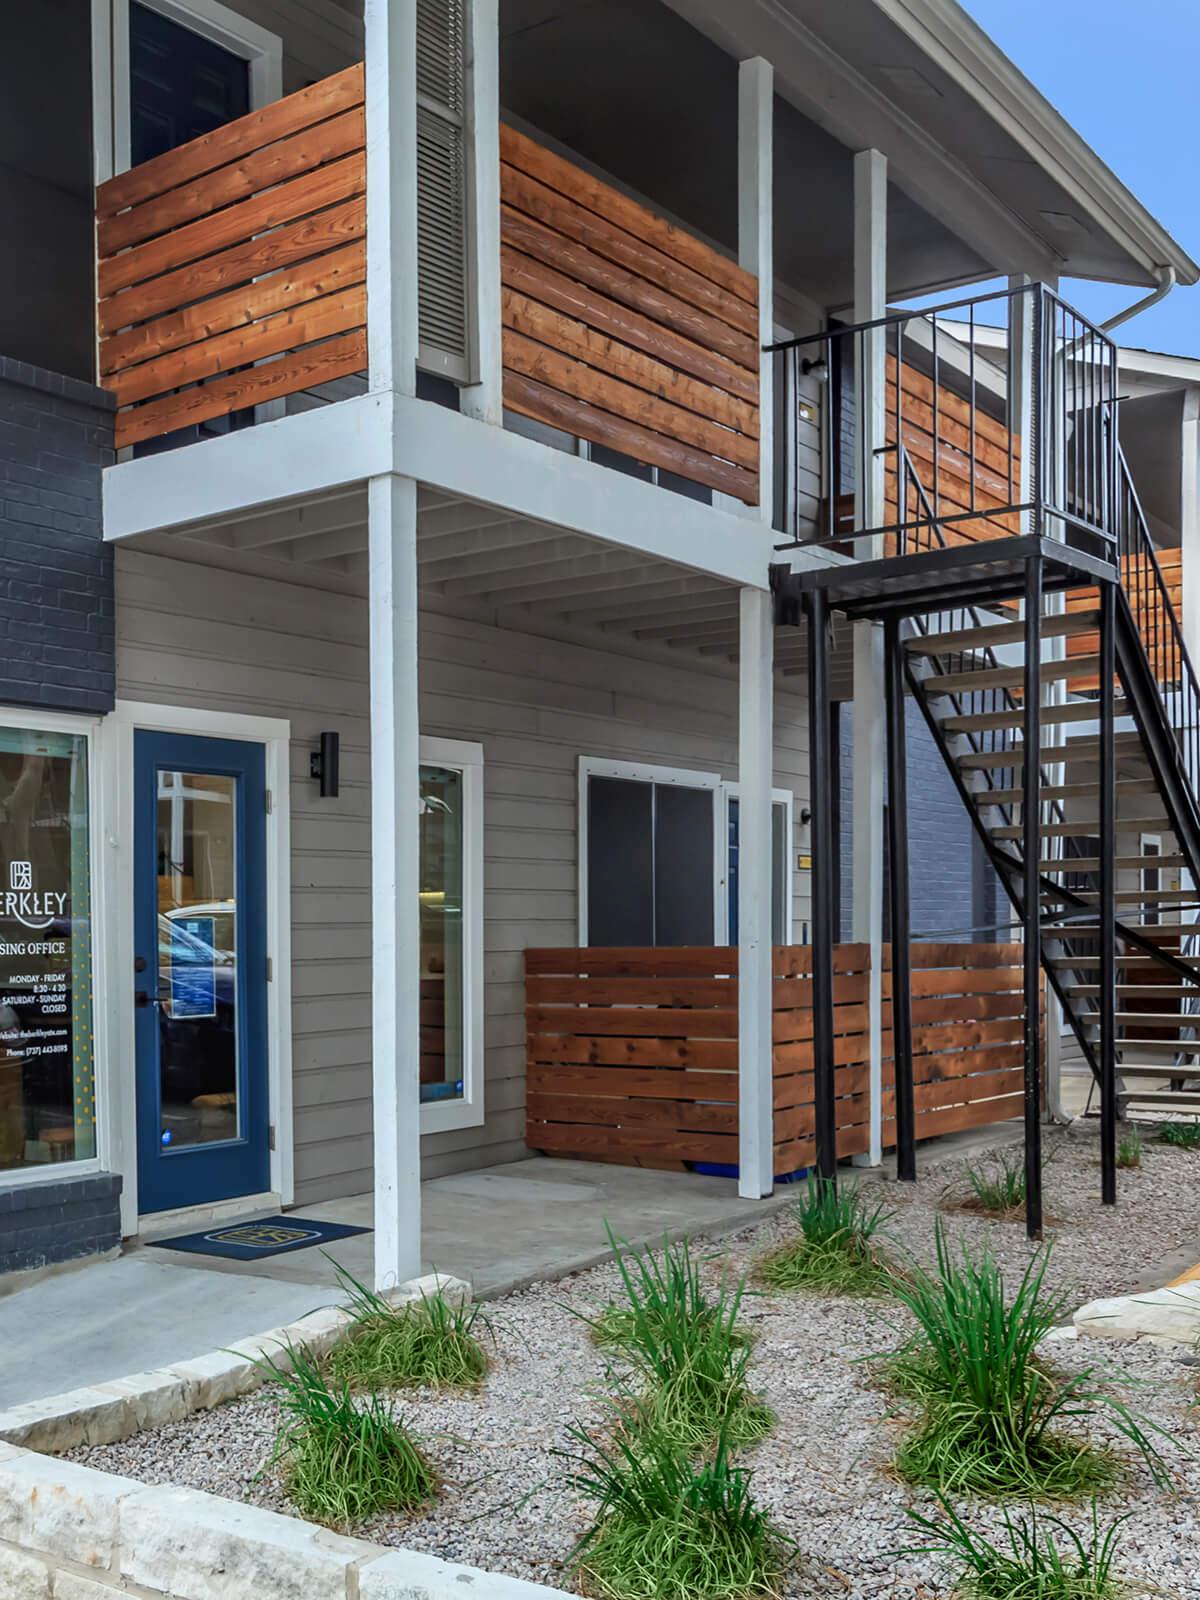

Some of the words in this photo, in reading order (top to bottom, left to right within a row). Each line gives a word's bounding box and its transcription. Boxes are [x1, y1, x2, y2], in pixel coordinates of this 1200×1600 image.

[27, 942, 65, 954] OFFICE
[9, 975, 40, 984] MONDAY
[43, 973, 66, 982] FRIDAY
[52, 983, 67, 992] 430
[1, 995, 36, 1005] SATURDAY
[39, 994, 67, 1003] SUNDAY
[41, 1004, 67, 1014] CLOSED
